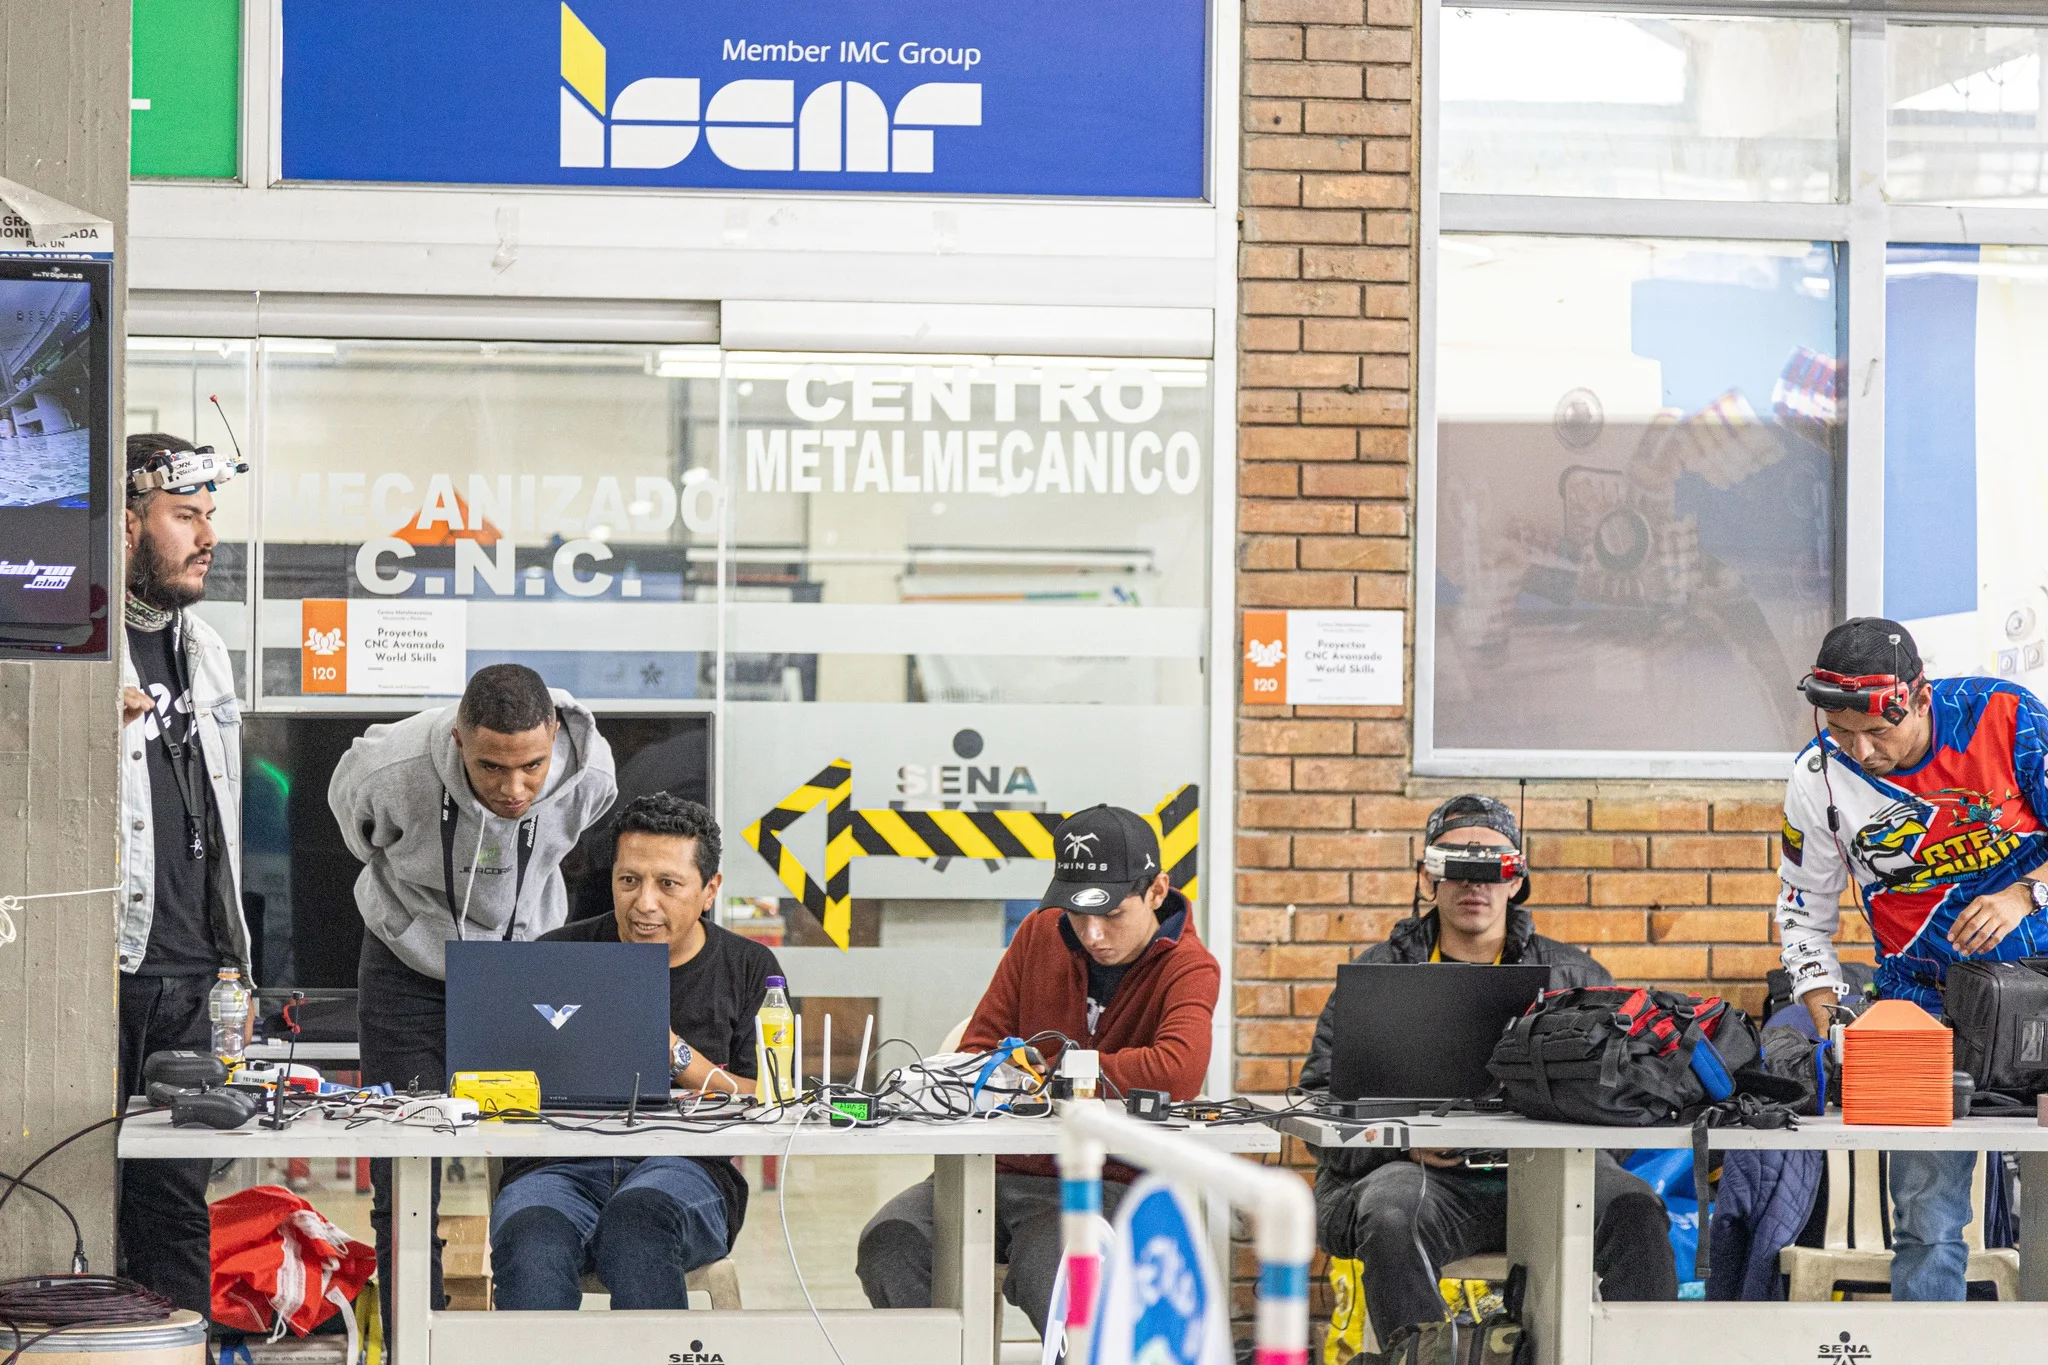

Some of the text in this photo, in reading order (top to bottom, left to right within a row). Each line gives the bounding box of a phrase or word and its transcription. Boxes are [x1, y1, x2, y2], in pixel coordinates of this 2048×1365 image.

[722, 38, 982, 71] Member IMC Group
[785, 363, 1164, 424] CENTRO
[745, 428, 1201, 495] METALMECANICO
[271, 472, 721, 534] MECANIZADO
[354, 537, 642, 597] C.N.C.
[377, 628, 428, 639] Proyectos
[364, 639, 445, 649] CNC Avanzado
[1317, 640, 1366, 650] Proyectos
[375, 652, 437, 662] World Skills
[1304, 652, 1328, 661] CNC
[312, 666, 337, 681] 120
[1316, 664, 1375, 674] World Skills
[1253, 677, 1278, 692] 120
[896, 764, 1038, 795] SENA
[1920, 828, 1992, 867] RTF
[1819, 1344, 1870, 1353] SENA
[669, 1353, 724, 1363] SENA
